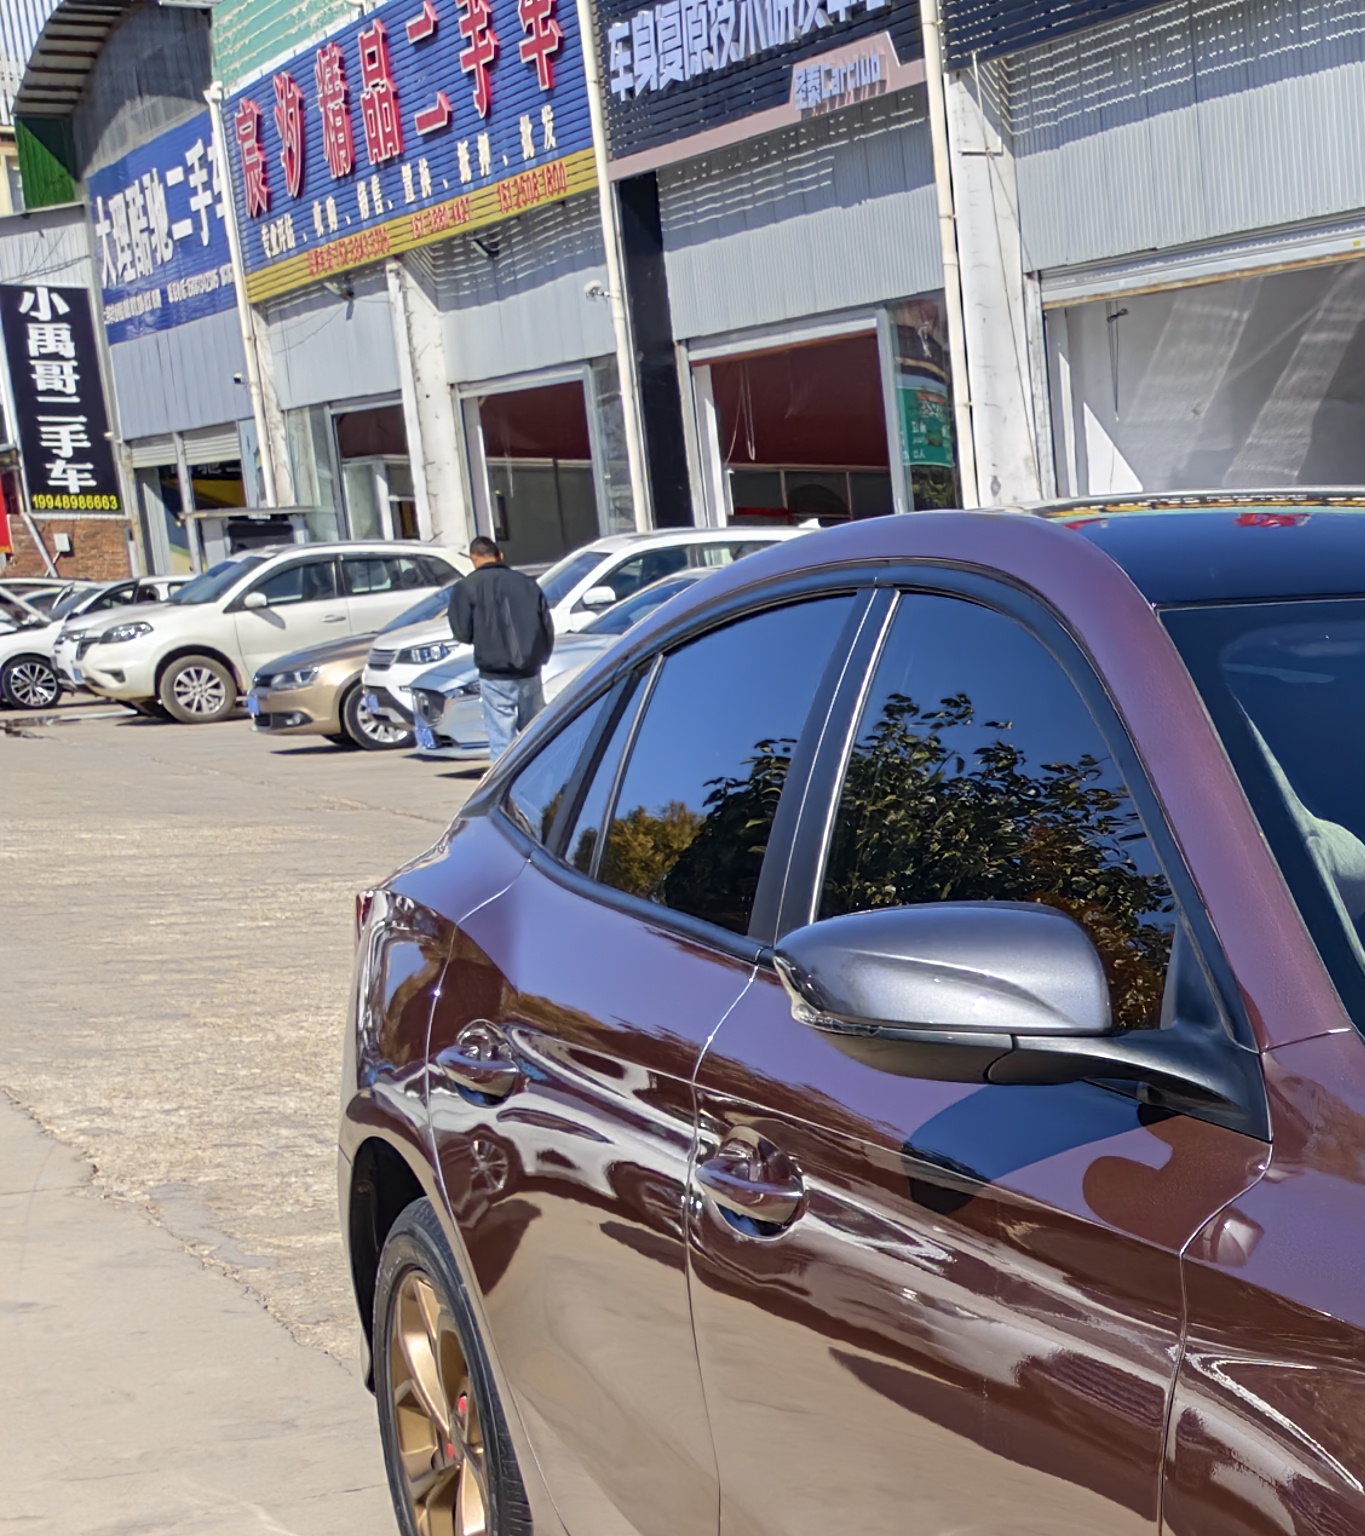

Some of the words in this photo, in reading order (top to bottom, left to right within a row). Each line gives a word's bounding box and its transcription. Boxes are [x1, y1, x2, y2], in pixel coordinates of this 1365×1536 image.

[18, 286, 97, 494] 小禹哥二手车
